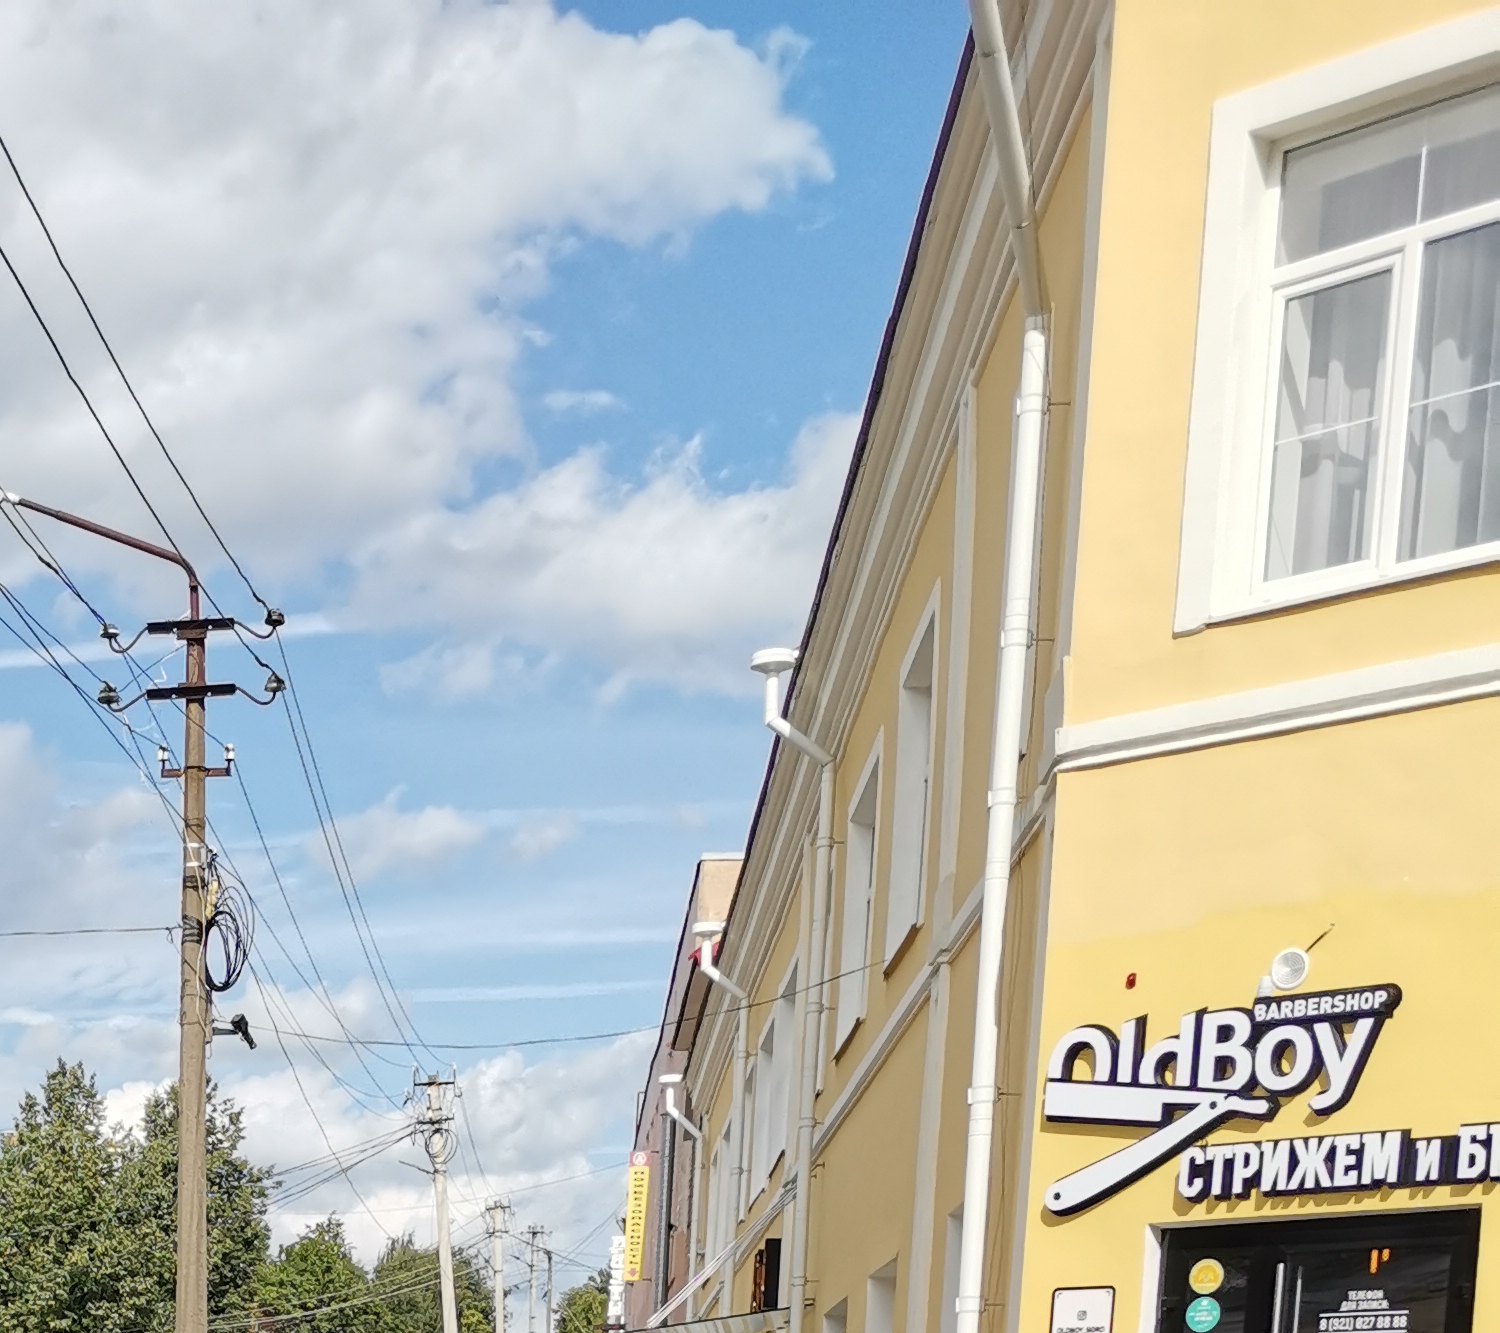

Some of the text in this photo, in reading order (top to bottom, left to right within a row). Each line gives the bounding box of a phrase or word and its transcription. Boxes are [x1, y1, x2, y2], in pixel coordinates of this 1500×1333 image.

[1254, 990, 1388, 1022] BARBERSHOP
[1046, 1007, 1376, 1112] OldBoy
[1178, 1131, 1402, 1198] СТРИЖЕМ
[1319, 1318, 1327, 1330] 8
